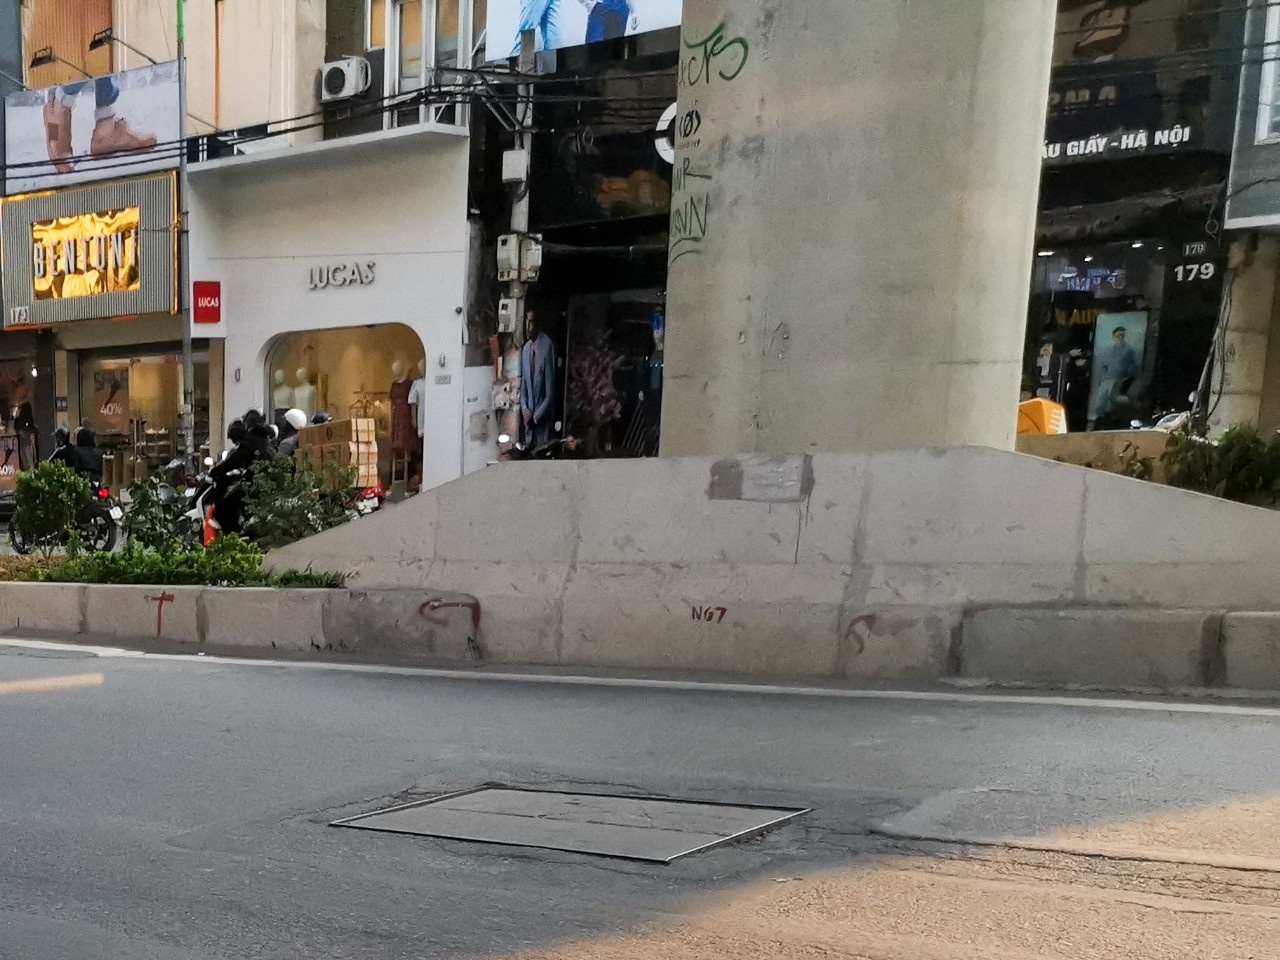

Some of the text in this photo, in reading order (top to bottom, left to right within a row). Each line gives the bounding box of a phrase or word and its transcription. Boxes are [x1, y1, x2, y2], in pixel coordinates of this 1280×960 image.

[1154, 124, 1191, 147] NỘI
[33, 230, 136, 278] BENTONI
[308, 261, 376, 291] LUCAS
[1174, 262, 1214, 282] 179
[198, 296, 219, 308] LUCAS
[99, 403, 123, 416] 40%
